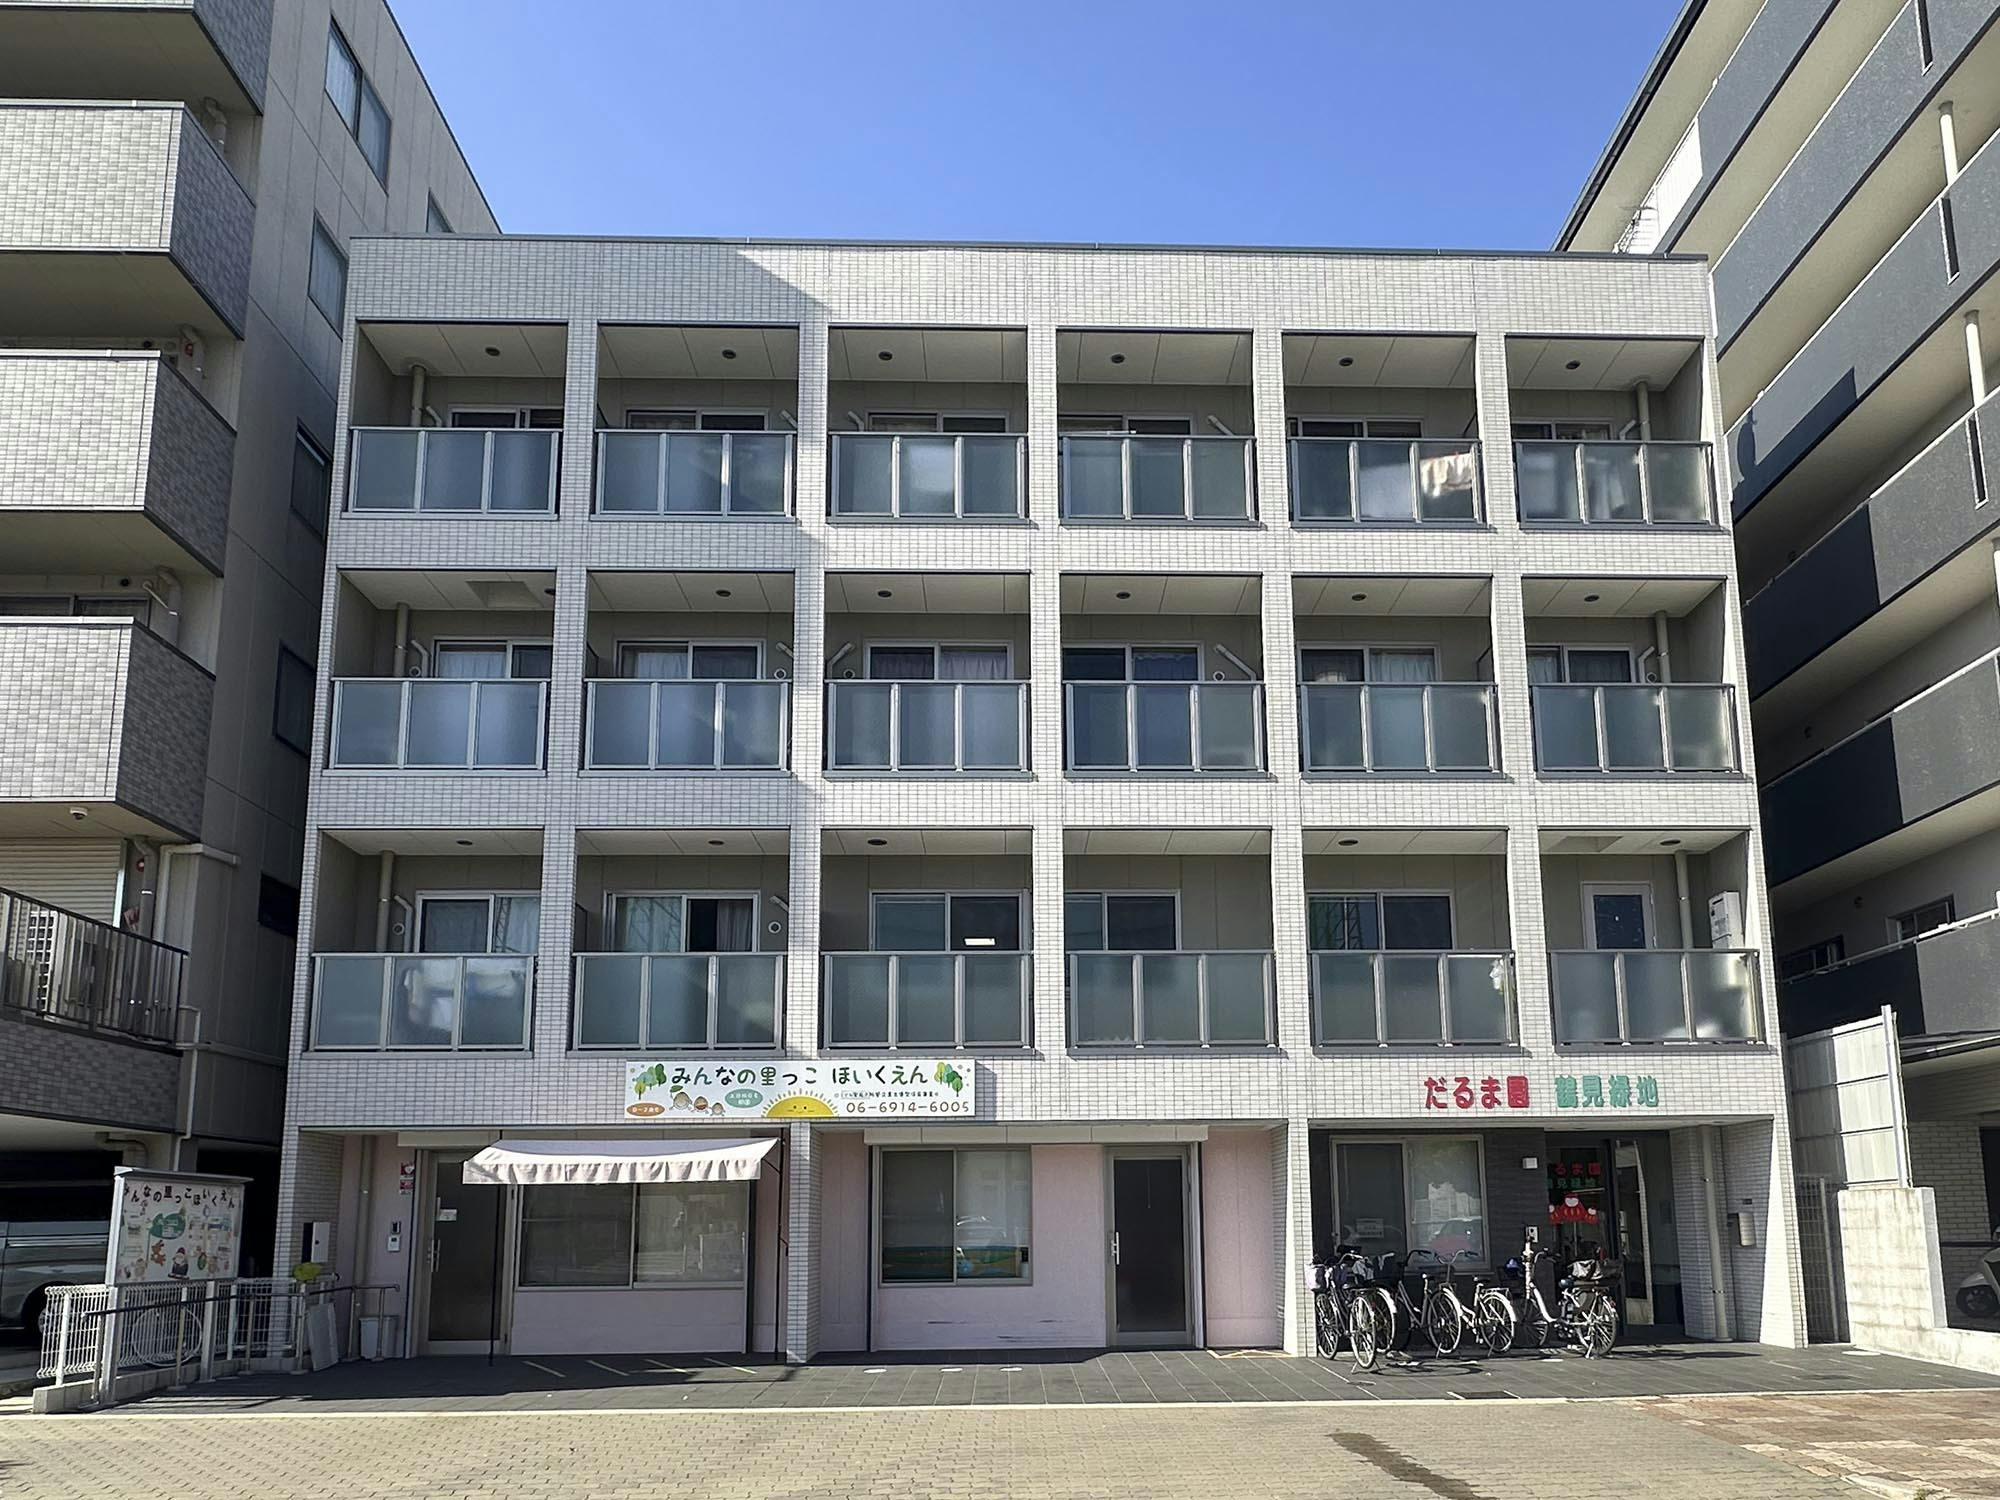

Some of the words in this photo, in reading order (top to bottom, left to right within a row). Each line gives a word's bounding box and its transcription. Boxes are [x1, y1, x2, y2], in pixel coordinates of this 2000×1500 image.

[671, 1066, 818, 1087] みんなの里っこ
[832, 1065, 928, 1085] ほいくえん
[1424, 1076, 1529, 1109] だるま園
[1554, 1074, 1659, 1108] 鶴見緑地
[846, 1101, 969, 1114] 06-6914-6005
